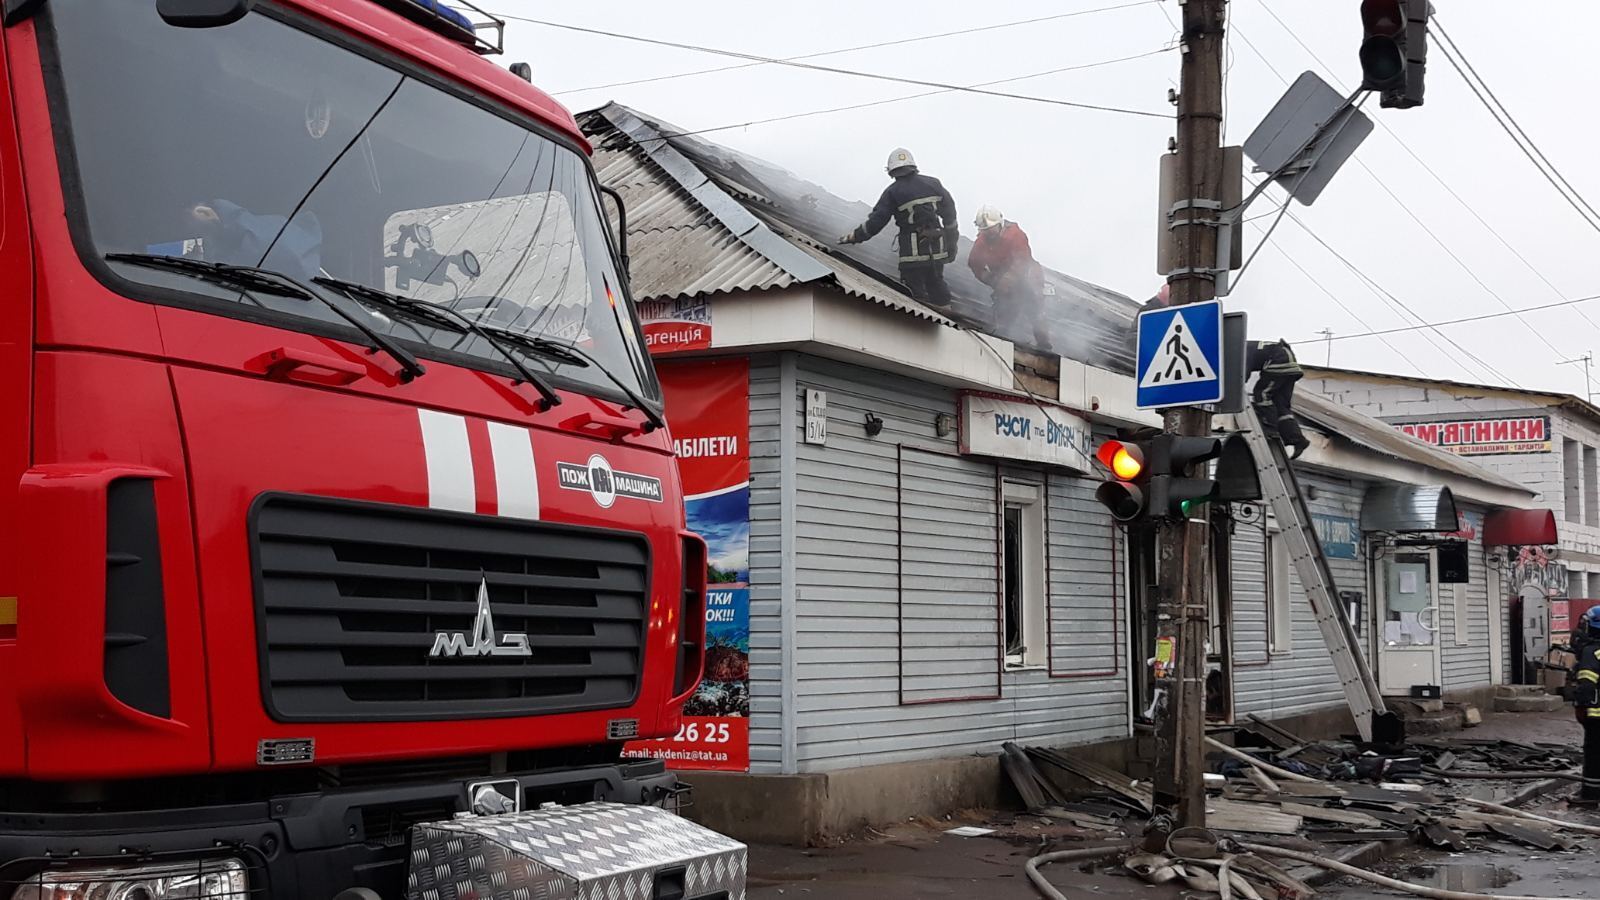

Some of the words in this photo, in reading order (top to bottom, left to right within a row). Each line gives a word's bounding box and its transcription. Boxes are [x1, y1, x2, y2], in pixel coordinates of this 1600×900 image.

[645, 326, 702, 346] агенція
[1395, 418, 1545, 445] АМ'ЯТНИКИ
[560, 468, 589, 485] ПОЖ
[615, 476, 660, 497] МАШИНА
[429, 577, 533, 656] МАЗ
[704, 722, 730, 743] 25
[653, 748, 728, 761] akdeniz@tat.ua
